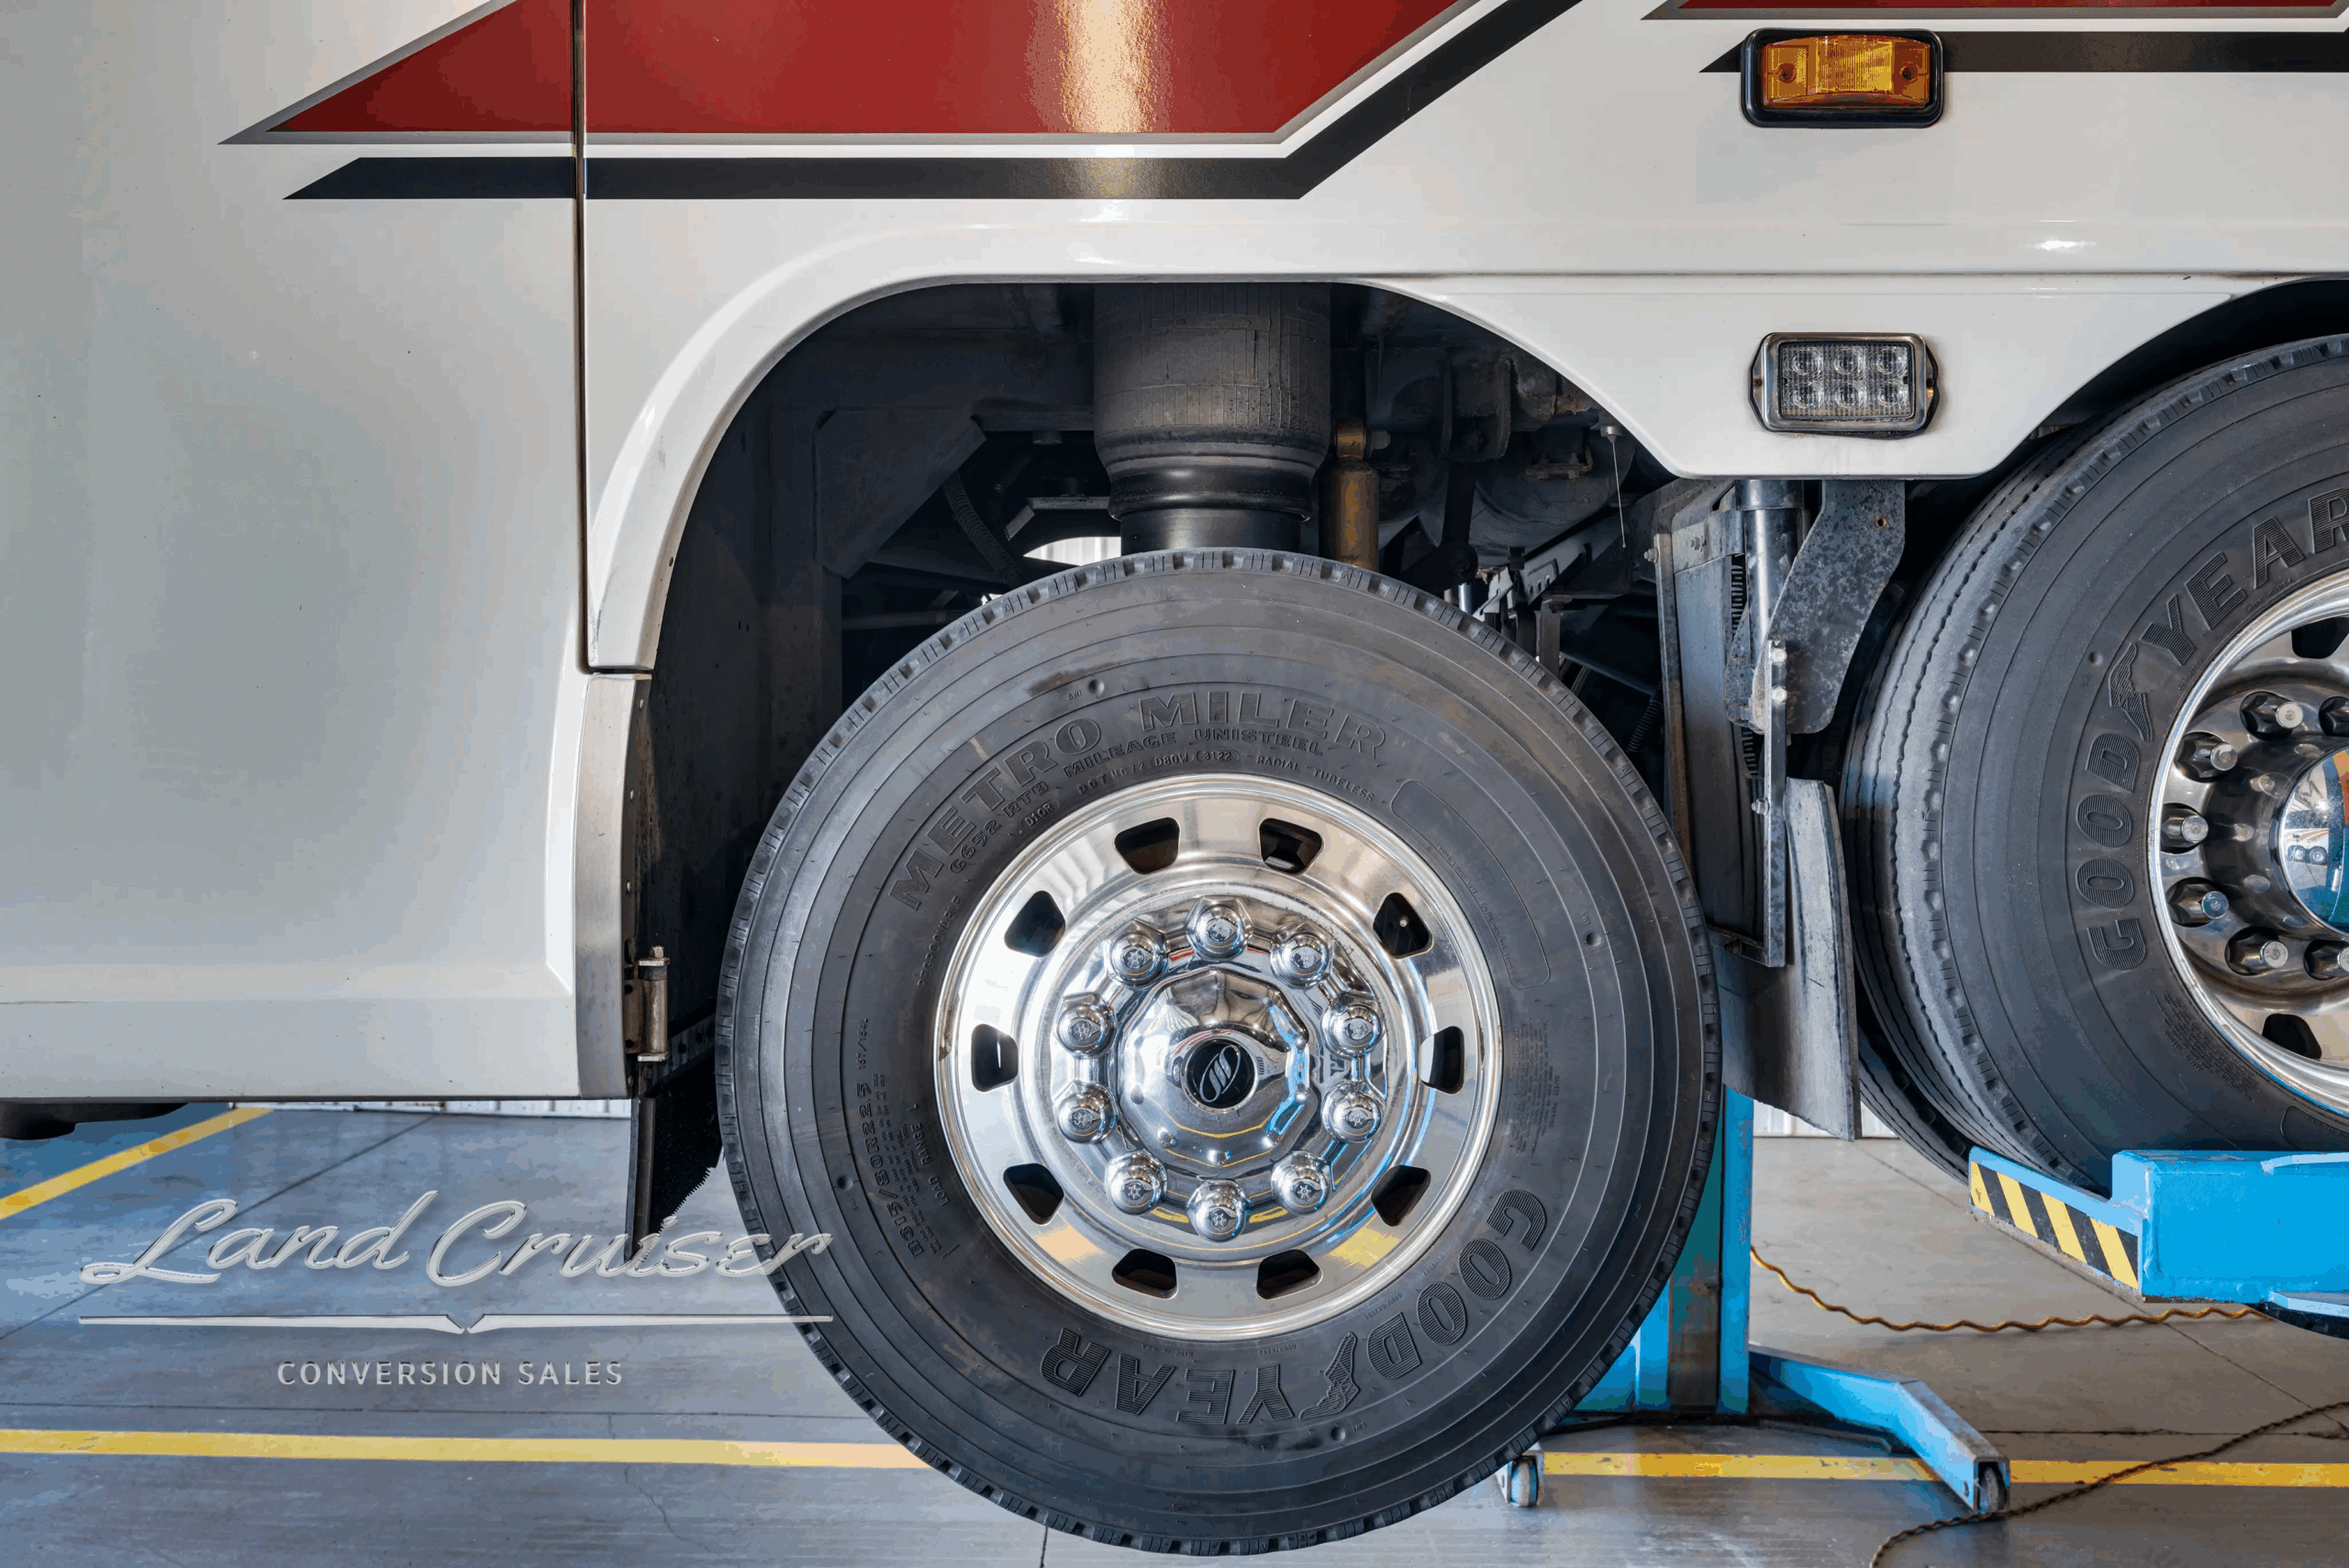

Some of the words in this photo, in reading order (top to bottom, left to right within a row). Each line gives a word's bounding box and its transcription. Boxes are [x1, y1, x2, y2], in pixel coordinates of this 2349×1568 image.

[1255, 752, 1300, 773] RADIAL
[887, 714, 1103, 909] METRO
[1137, 689, 1388, 761] MILER
[945, 814, 1003, 877] G652
[1000, 777, 1050, 818] RTB
[1060, 729, 1176, 779] MILEAGE
[1193, 726, 1326, 758] UNISTEEL
[1312, 765, 1376, 804] TUBELESS
[906, 1102, 918, 1112] L
[909, 1121, 933, 1166] RANGE
[926, 1173, 951, 1207] LOAD
[1039, 1188, 1548, 1425] GOODYEAR
